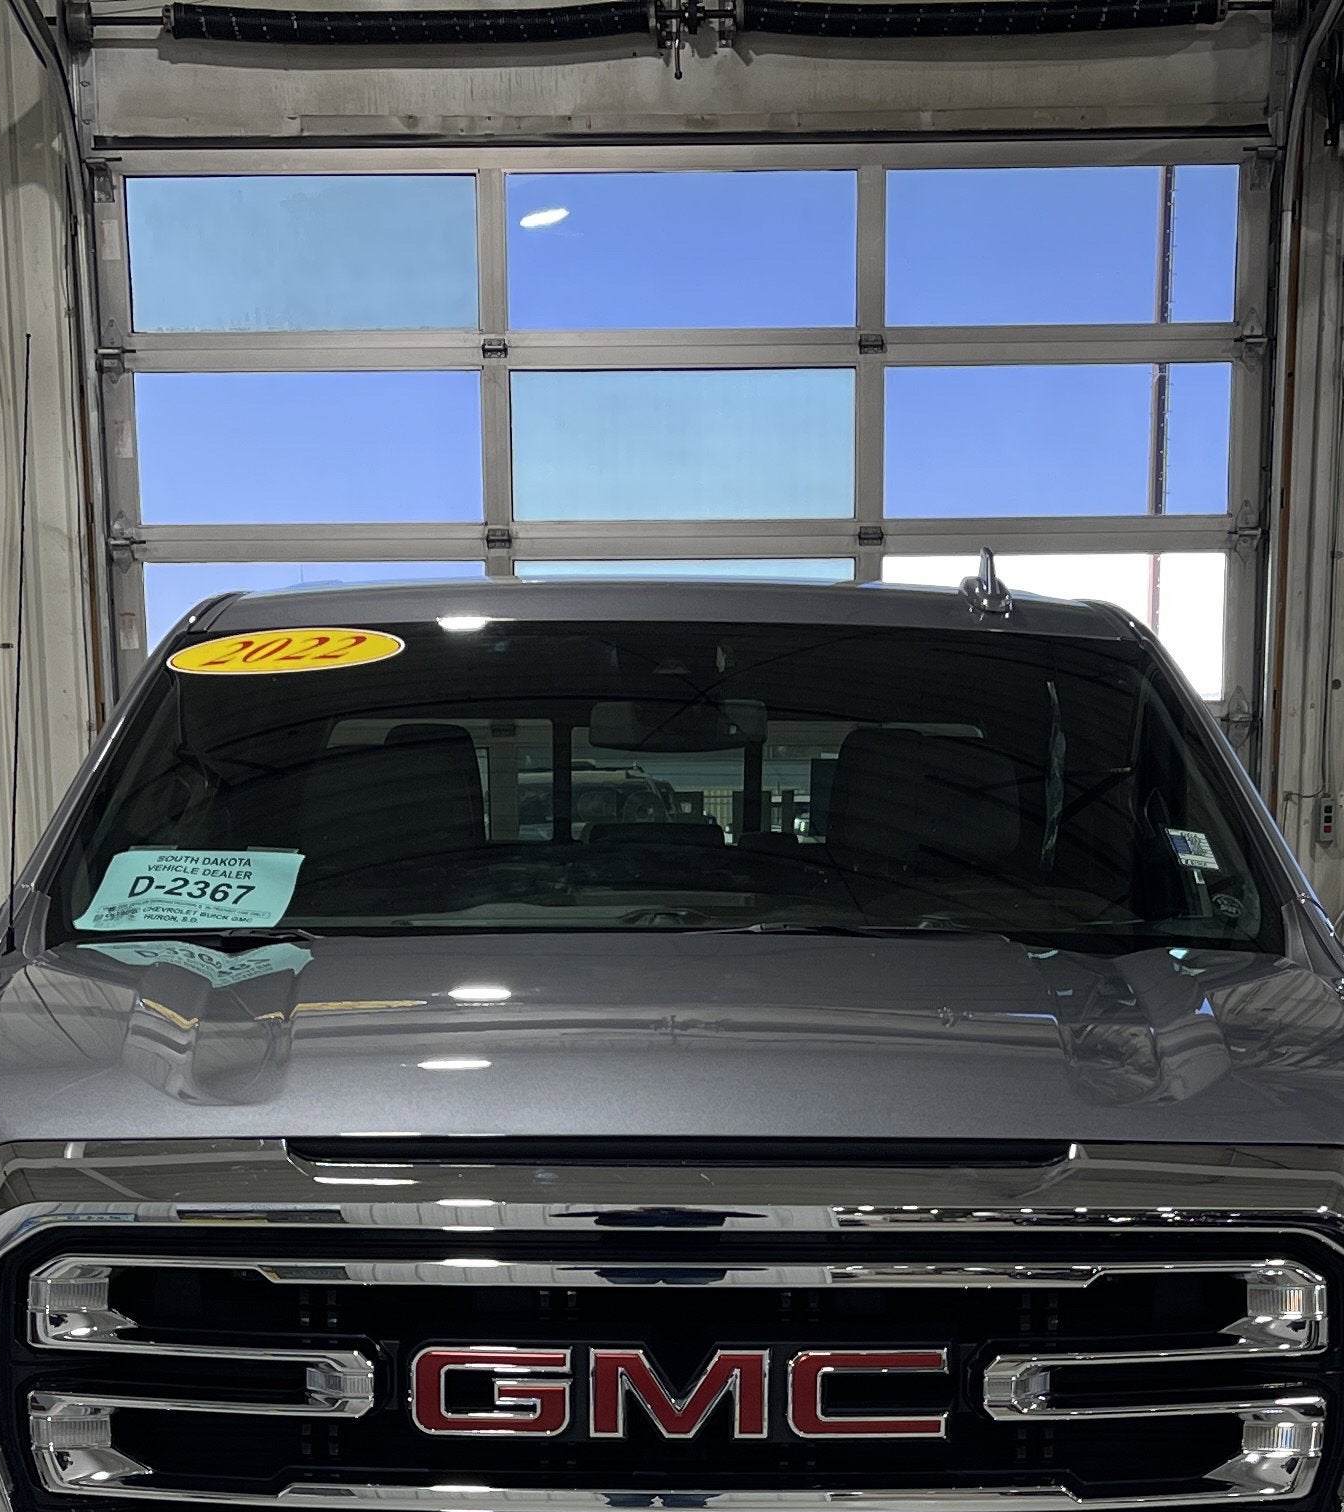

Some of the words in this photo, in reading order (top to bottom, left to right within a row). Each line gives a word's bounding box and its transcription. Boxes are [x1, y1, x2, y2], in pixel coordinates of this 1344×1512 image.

[200, 636, 367, 666] 2022
[147, 864, 199, 875] VEHICLE
[202, 868, 253, 880] DEALER
[157, 855, 199, 865] SOUTH
[202, 857, 252, 868] DAKOTA
[128, 876, 256, 905] D-2367
[142, 905, 198, 917] CHEVROLET
[411, 1345, 949, 1438] GMC
